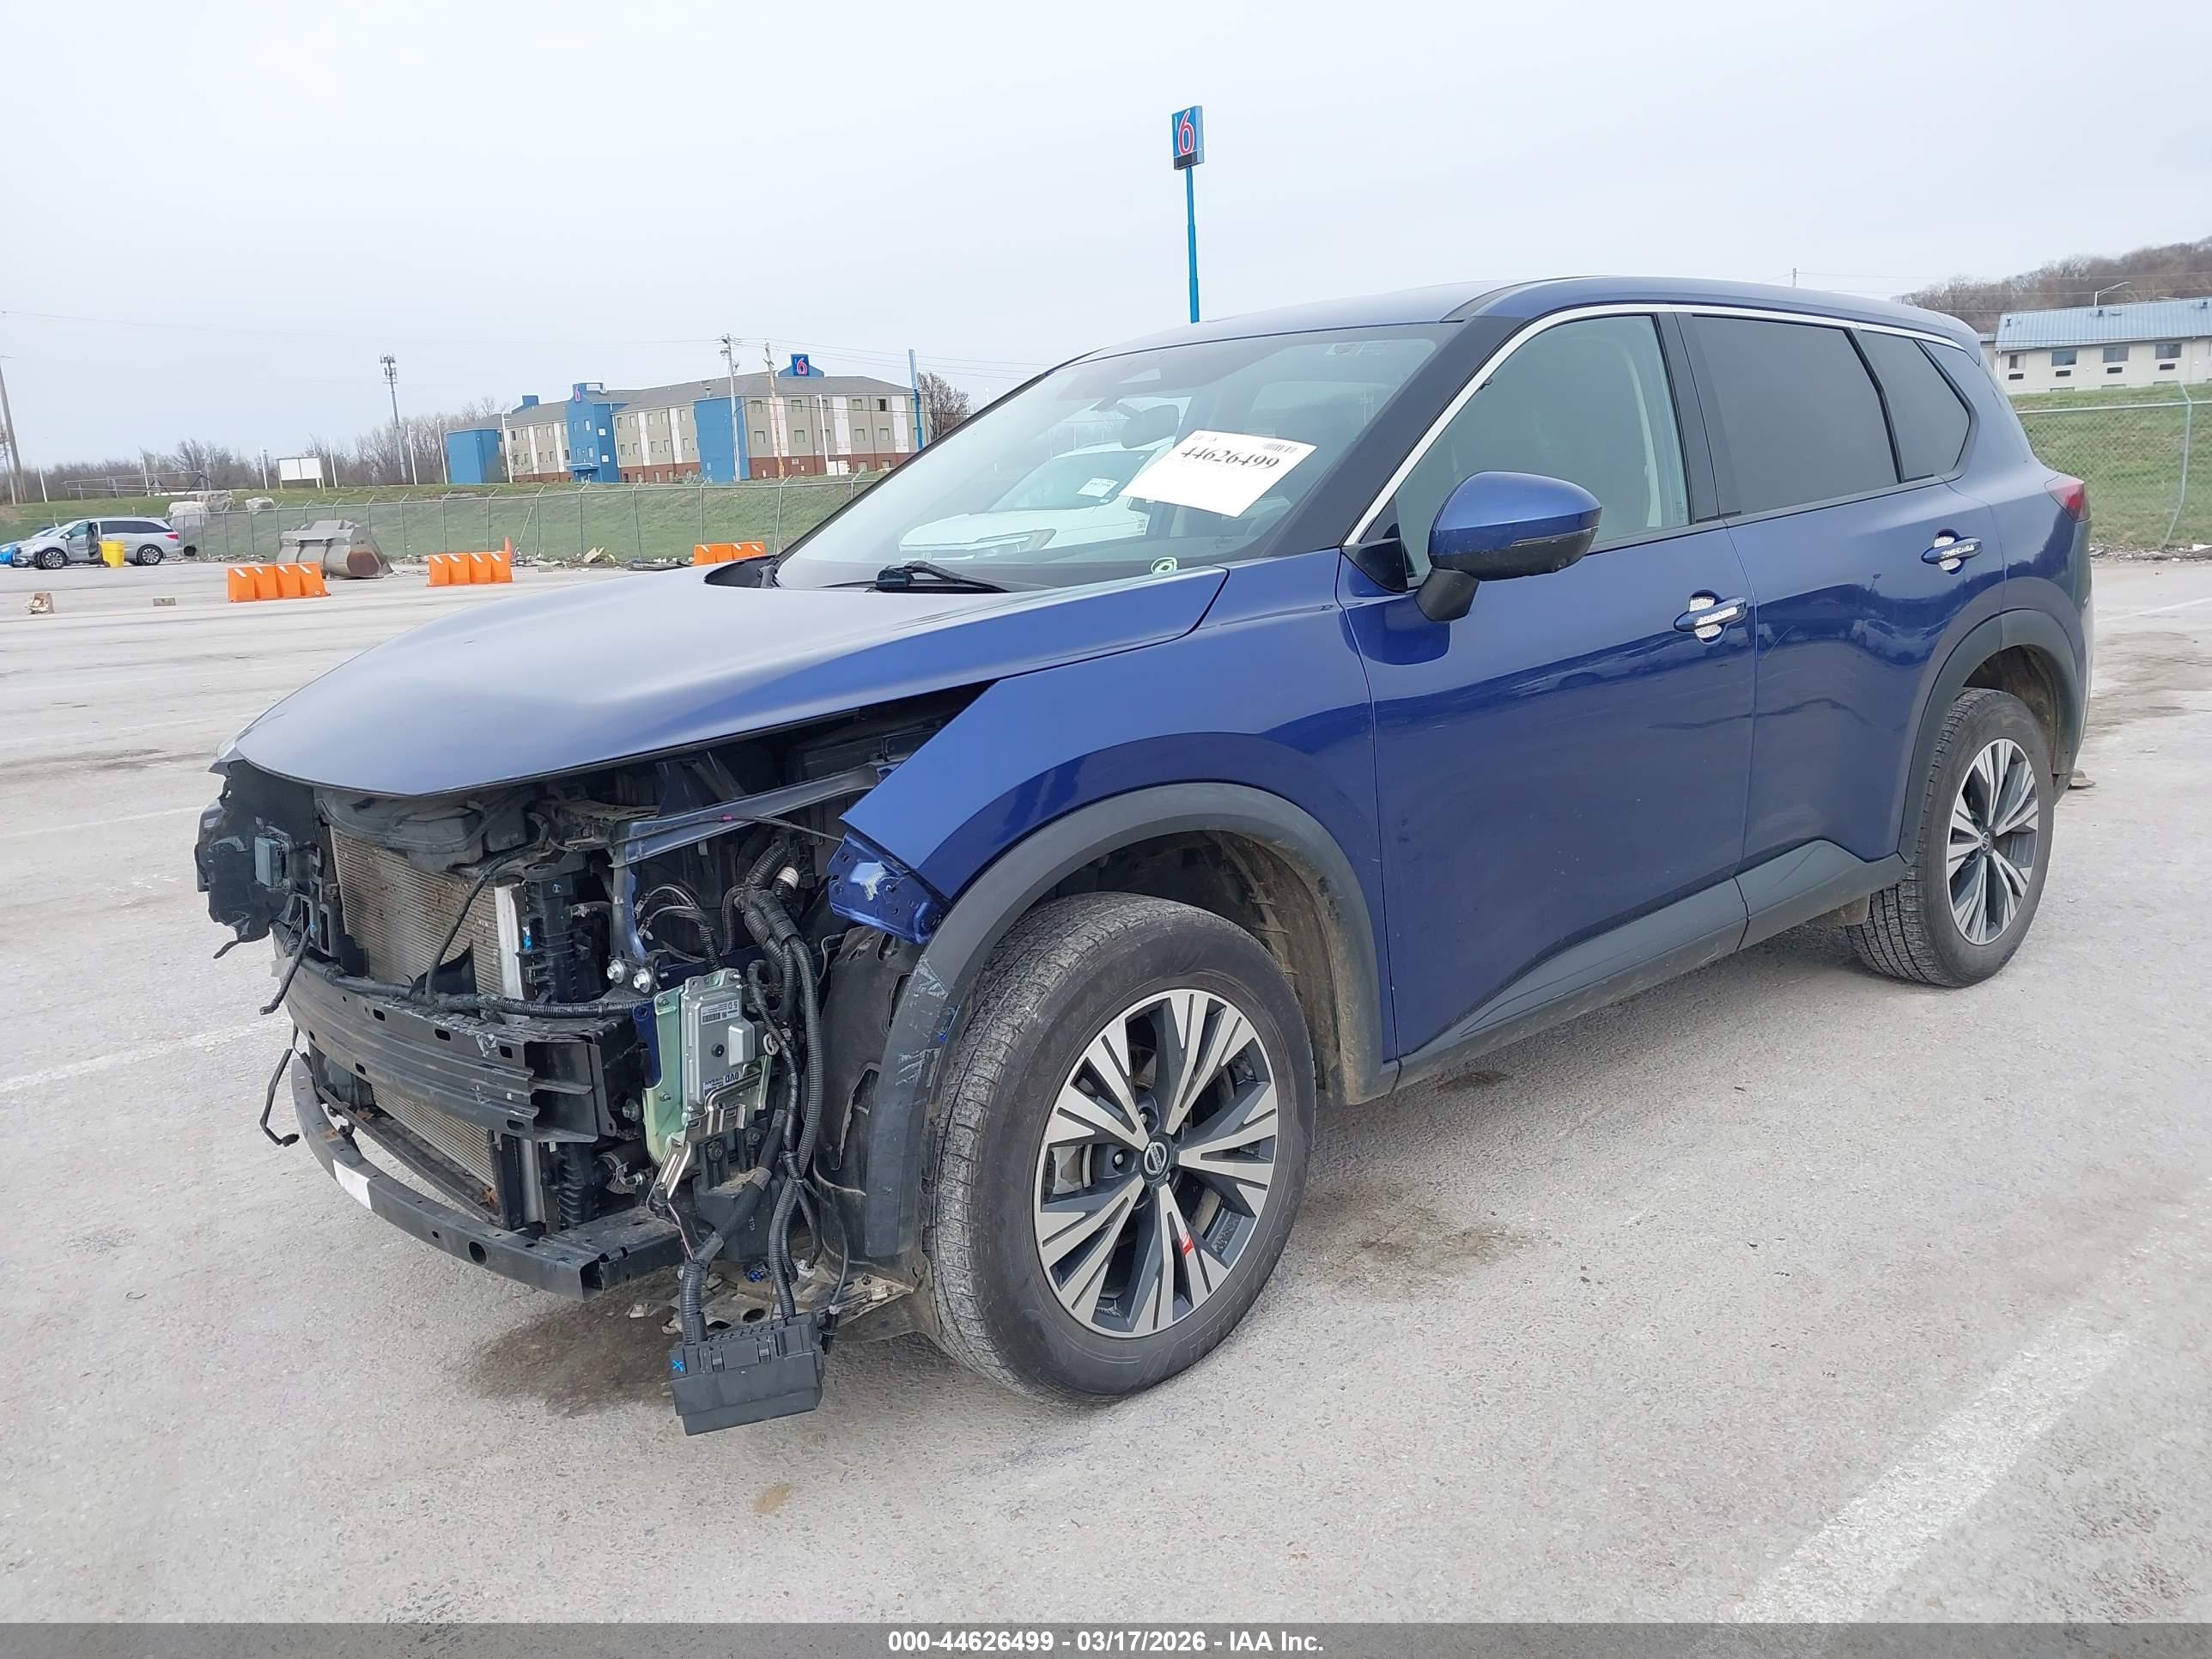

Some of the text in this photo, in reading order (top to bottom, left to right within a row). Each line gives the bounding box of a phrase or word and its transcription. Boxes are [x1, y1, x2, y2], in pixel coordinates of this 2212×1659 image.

[1178, 110, 1194, 155] 6
[797, 357, 807, 375] 6
[1182, 447, 1280, 470] 44626499
